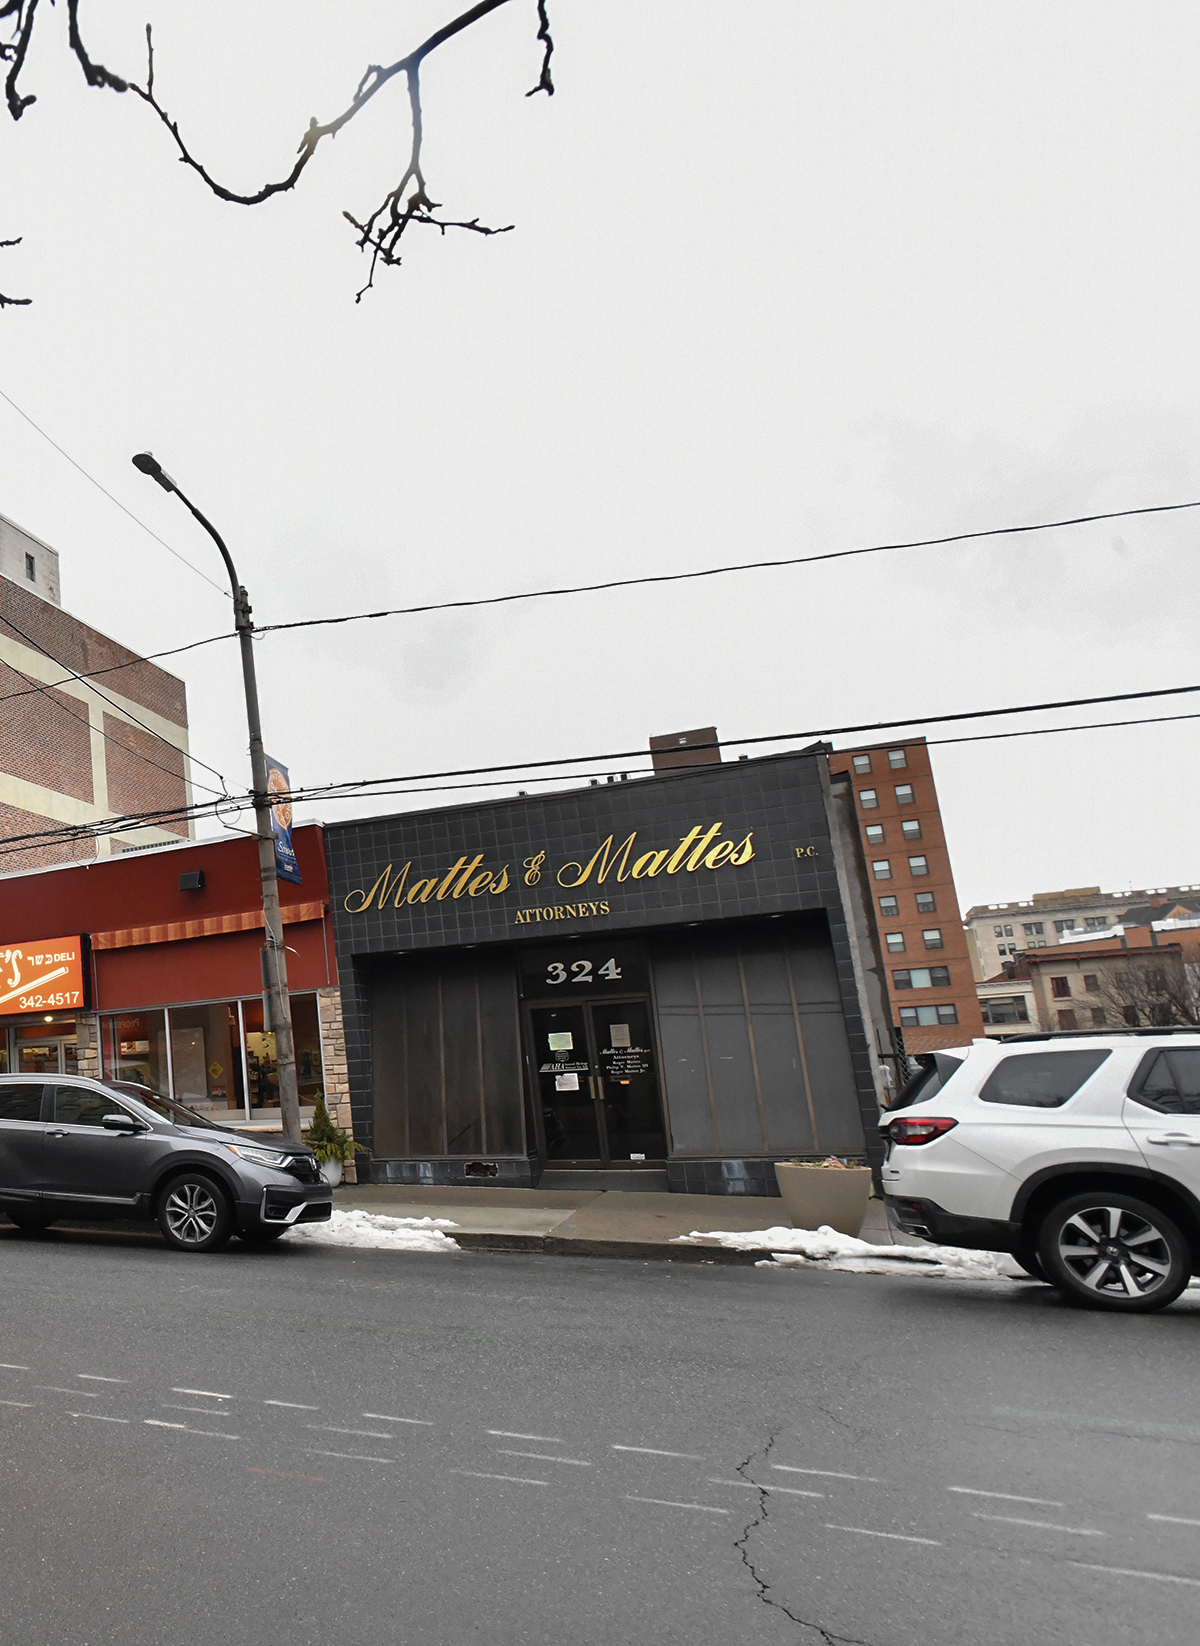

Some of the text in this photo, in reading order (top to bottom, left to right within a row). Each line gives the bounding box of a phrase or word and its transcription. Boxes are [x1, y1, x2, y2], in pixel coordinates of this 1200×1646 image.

[796, 846, 819, 858] P.C.
[344, 822, 756, 914] Mattes & Mattes
[514, 900, 610, 924] ATTORNEYS
[54, 952, 75, 962] DELI
[546, 957, 622, 985] 324
[19, 991, 80, 1009] 342-4517
